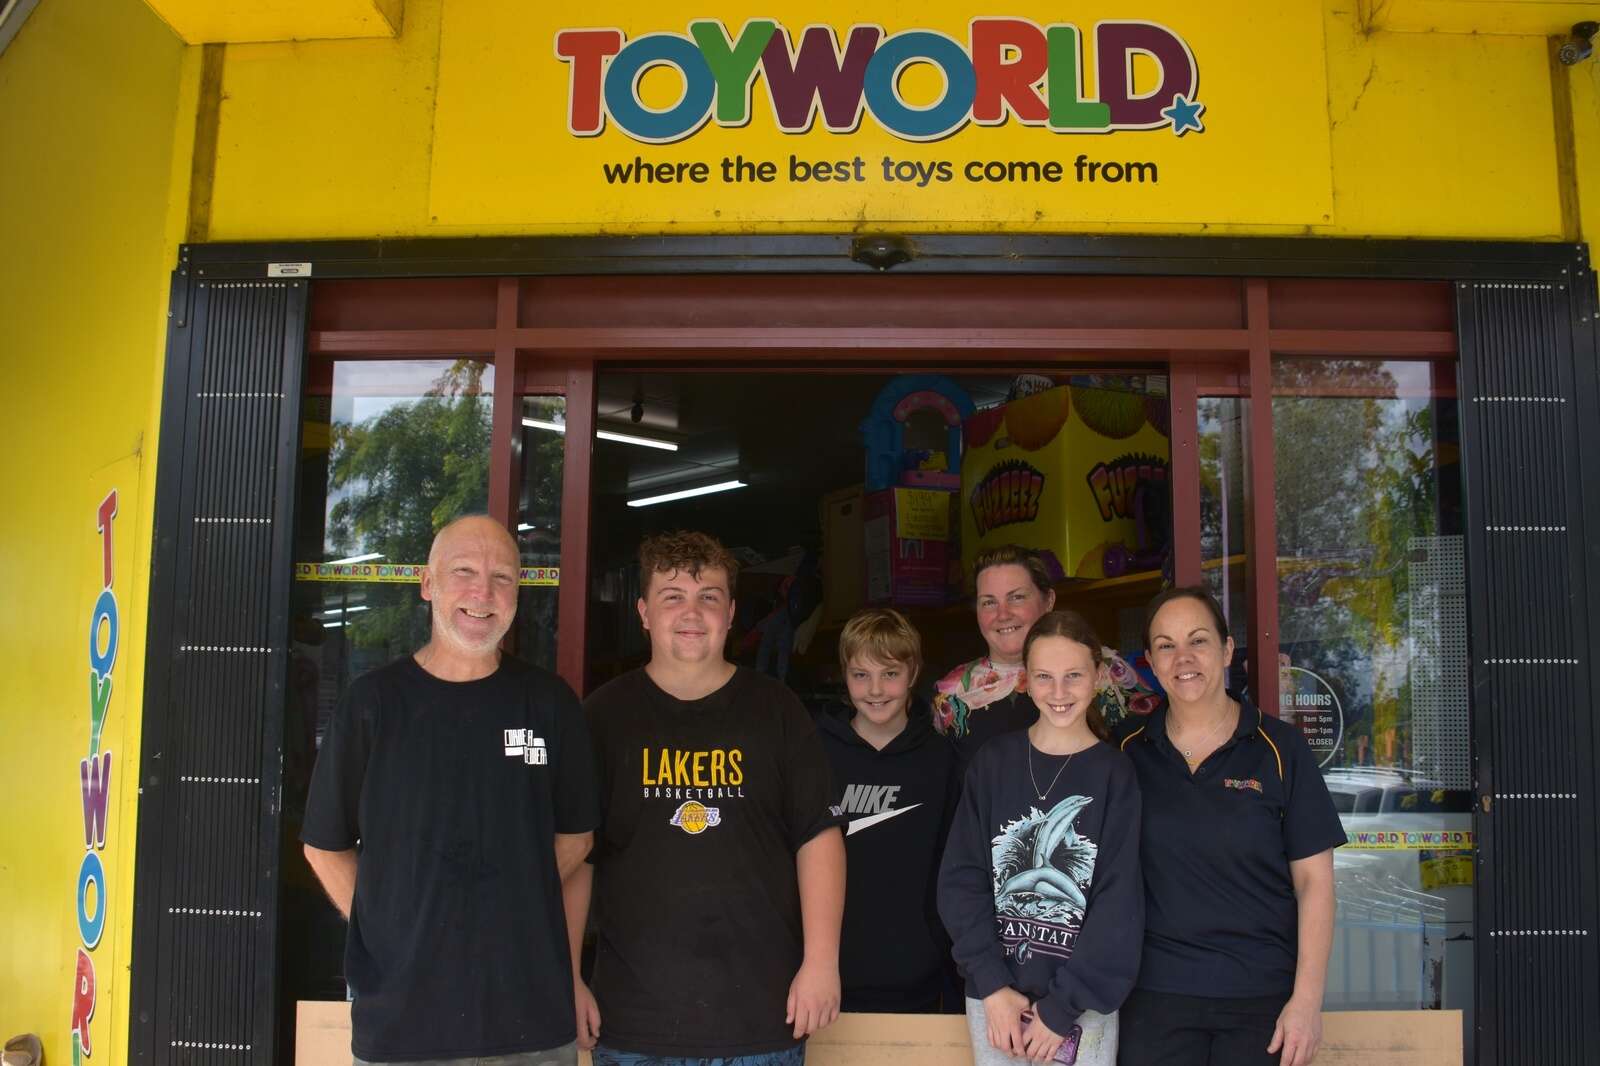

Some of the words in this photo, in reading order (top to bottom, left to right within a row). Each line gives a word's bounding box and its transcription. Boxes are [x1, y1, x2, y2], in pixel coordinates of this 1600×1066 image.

[554, 18, 1200, 143] TOYWORLD
[603, 155, 709, 183] where
[721, 155, 776, 183] the
[789, 155, 865, 182] best
[882, 157, 953, 187] toys
[964, 160, 1062, 183] come
[1074, 155, 1158, 183] from
[315, 564, 371, 576] TOYWORLD
[375, 565, 422, 577] TOYWOR
[519, 568, 559, 580] WORLD
[1296, 694, 1332, 706] HOURS
[1308, 738, 1333, 746] CLOSED
[643, 748, 743, 786] LAKERS
[644, 787, 744, 799] BASKETBALL
[839, 784, 901, 814] NIKE
[1401, 832, 1464, 844] TOYWORLD
